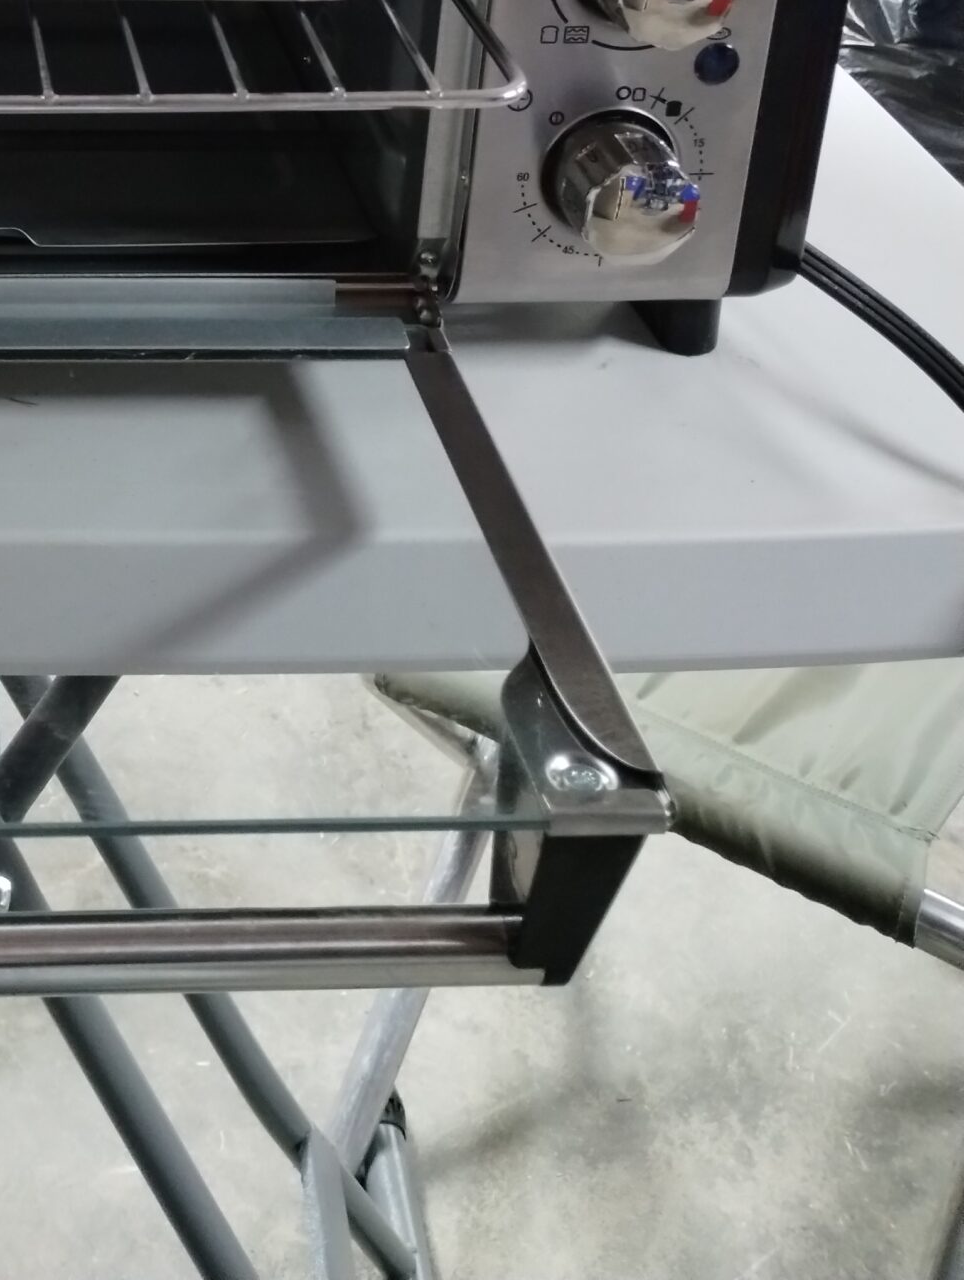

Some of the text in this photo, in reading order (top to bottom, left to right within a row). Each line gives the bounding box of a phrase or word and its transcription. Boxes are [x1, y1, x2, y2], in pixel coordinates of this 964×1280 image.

[693, 137, 705, 148] 15
[516, 172, 530, 182] 60
[562, 246, 575, 255] 45
